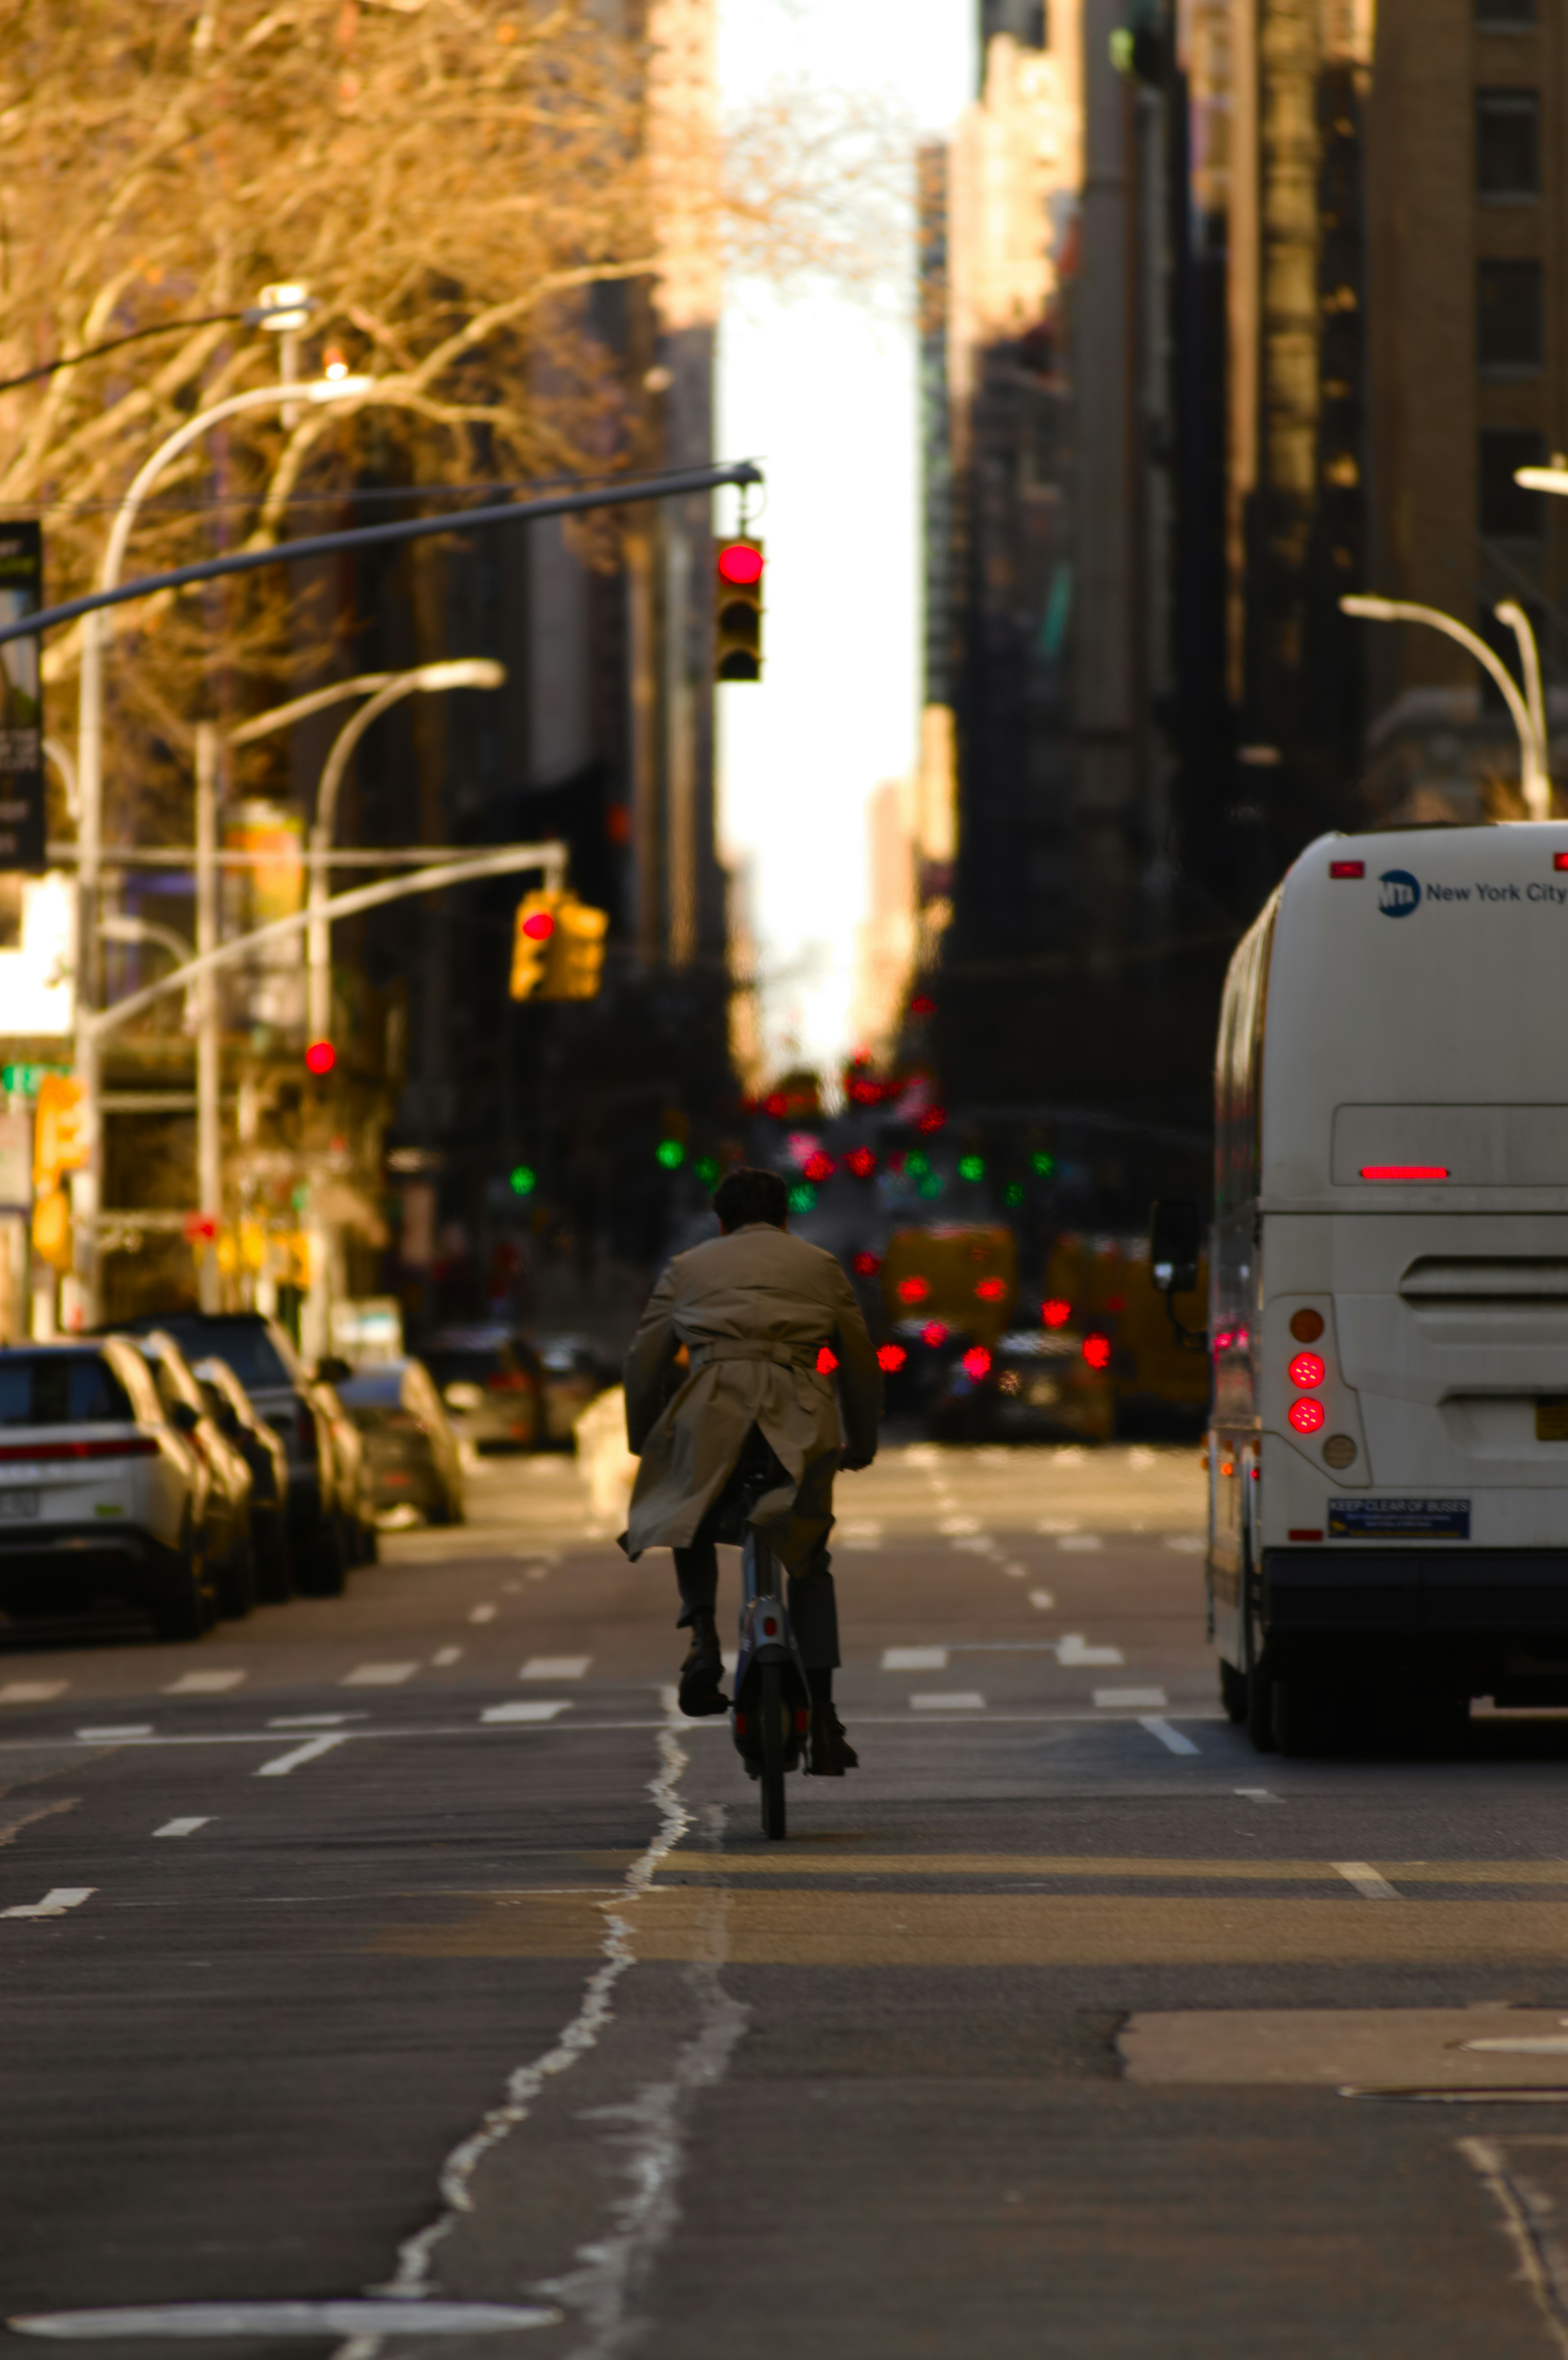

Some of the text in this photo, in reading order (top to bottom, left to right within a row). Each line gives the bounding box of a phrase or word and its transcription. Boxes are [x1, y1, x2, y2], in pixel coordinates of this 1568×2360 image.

[1379, 881, 1415, 907] MTA
[1426, 882, 1568, 904] New York City
[1330, 1501, 1469, 1512] KEEP CLEAR OF BUSES
